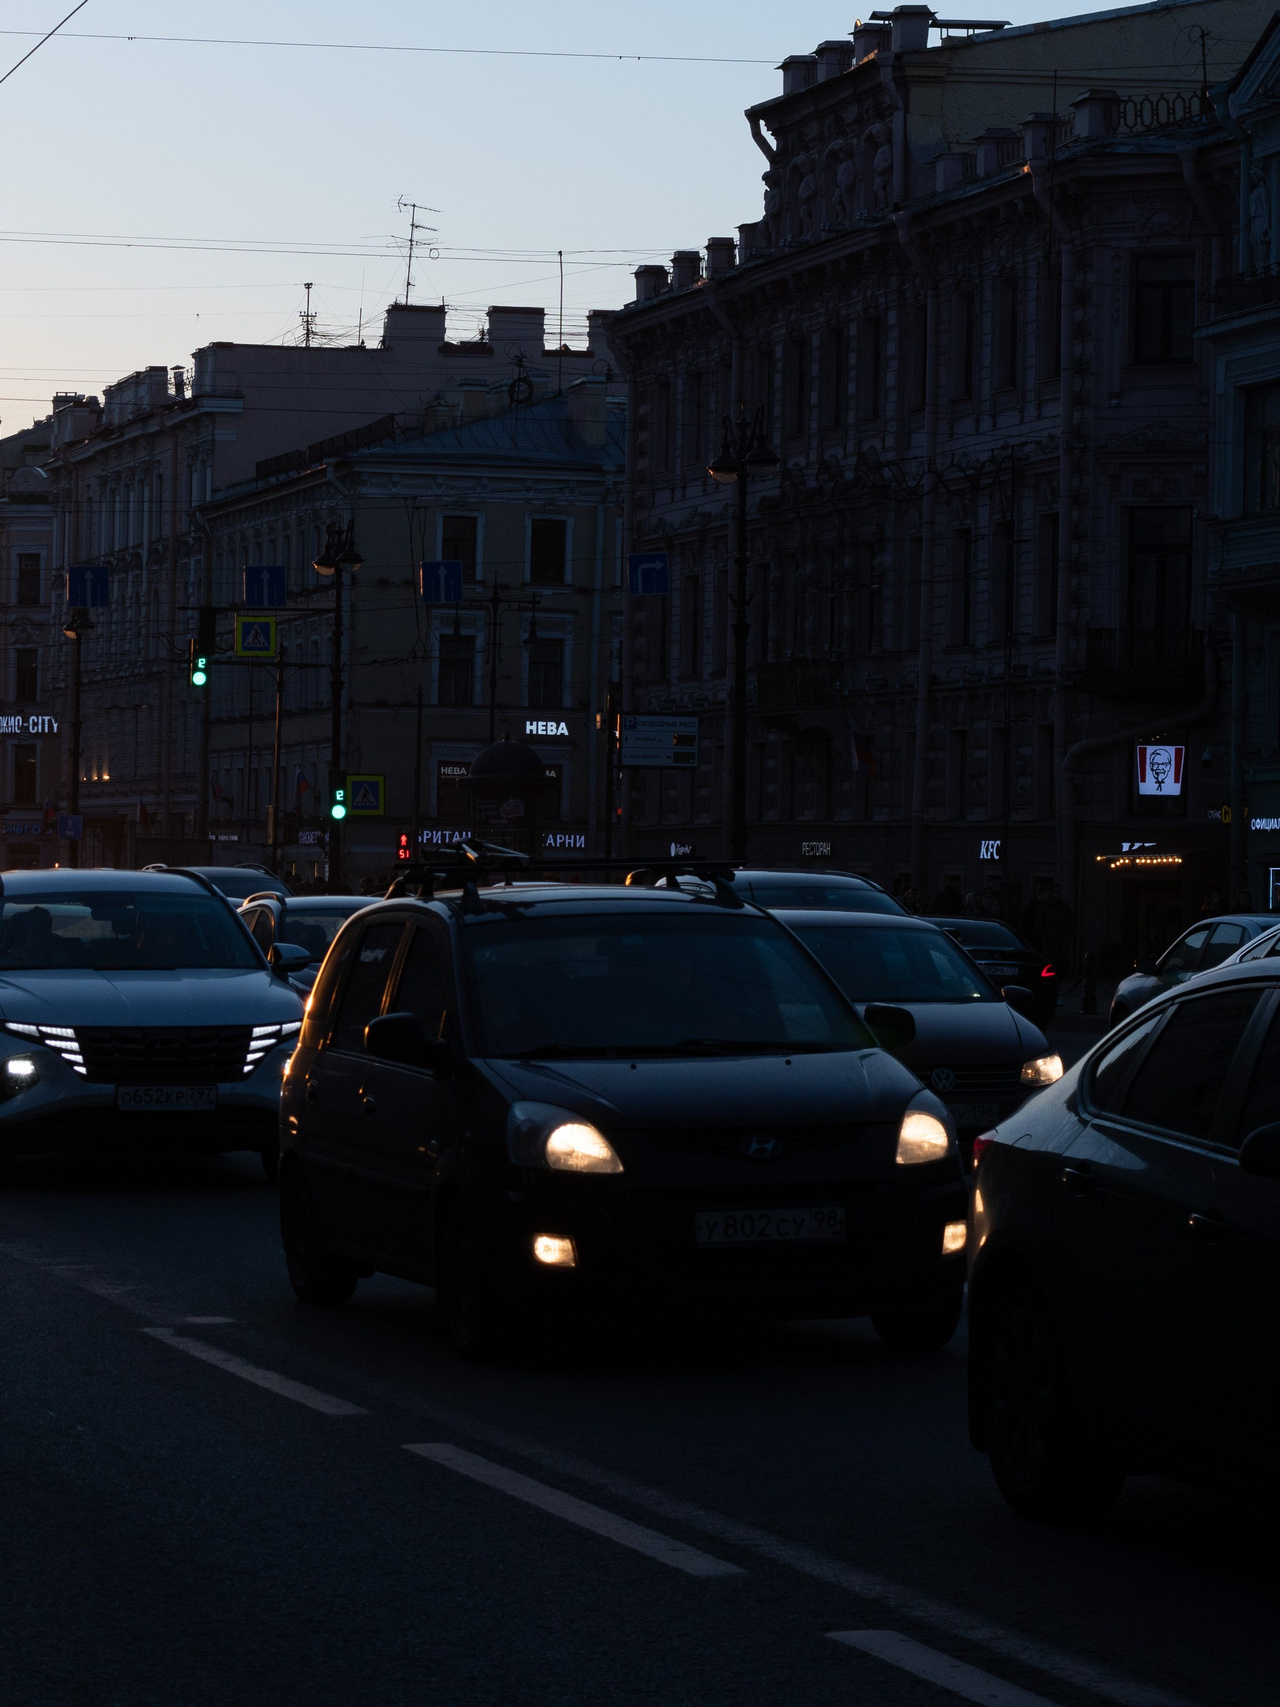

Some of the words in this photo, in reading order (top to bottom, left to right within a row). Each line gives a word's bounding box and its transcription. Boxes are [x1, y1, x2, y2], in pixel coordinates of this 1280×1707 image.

[525, 721, 570, 736] НЕВА
[637, 720, 677, 728] СВОБОДНЫХ
[679, 720, 697, 729] МЕСТ
[440, 766, 468, 776] НЕВА
[542, 834, 586, 848] АРНИ
[801, 841, 832, 857] РЕСТОРАН
[979, 840, 1001, 861] KFC
[189, 1086, 212, 1100] 797
[706, 1213, 805, 1239] У802СУ
[814, 1209, 836, 1231] 98
